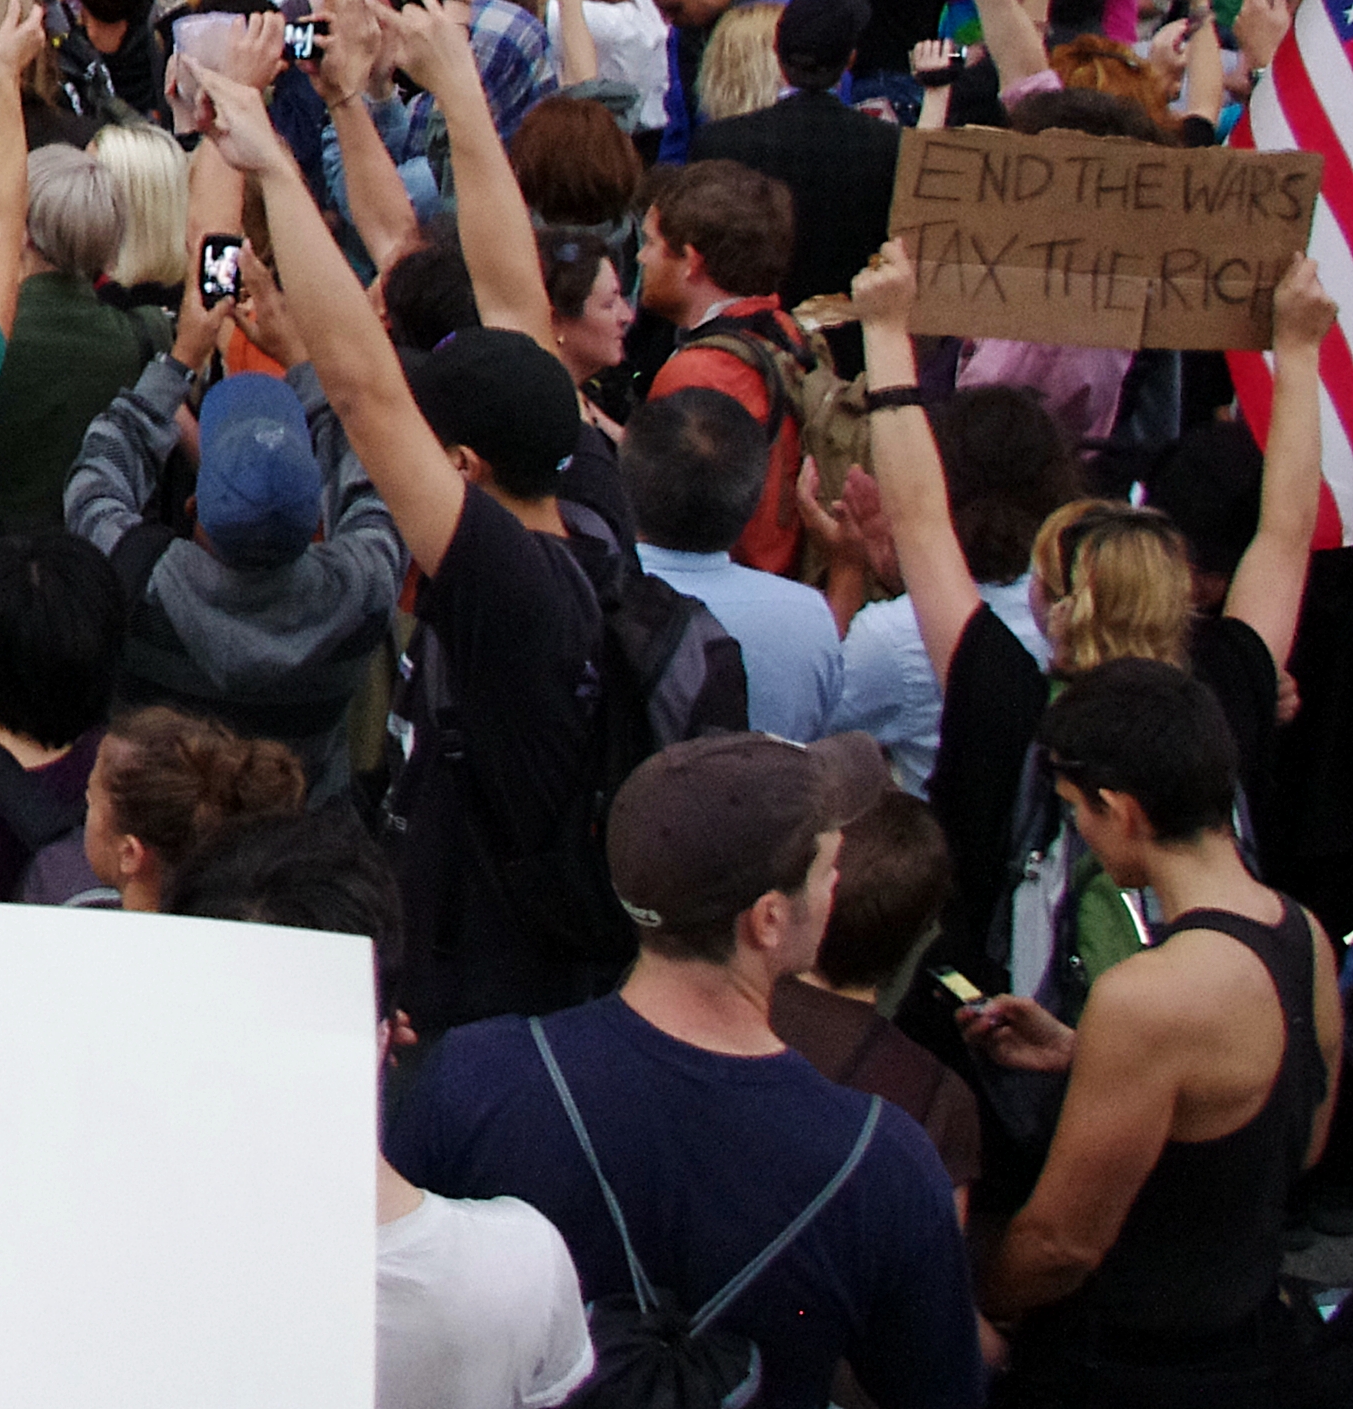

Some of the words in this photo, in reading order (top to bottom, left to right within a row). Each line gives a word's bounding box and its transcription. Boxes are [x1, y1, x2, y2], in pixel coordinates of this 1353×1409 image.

[911, 140, 1057, 205] END
[1067, 156, 1168, 212] THE
[1183, 156, 1308, 225] WARS
[897, 219, 1019, 304] TAX
[1029, 236, 1137, 312] THE
[1160, 248, 1282, 322] RICH
